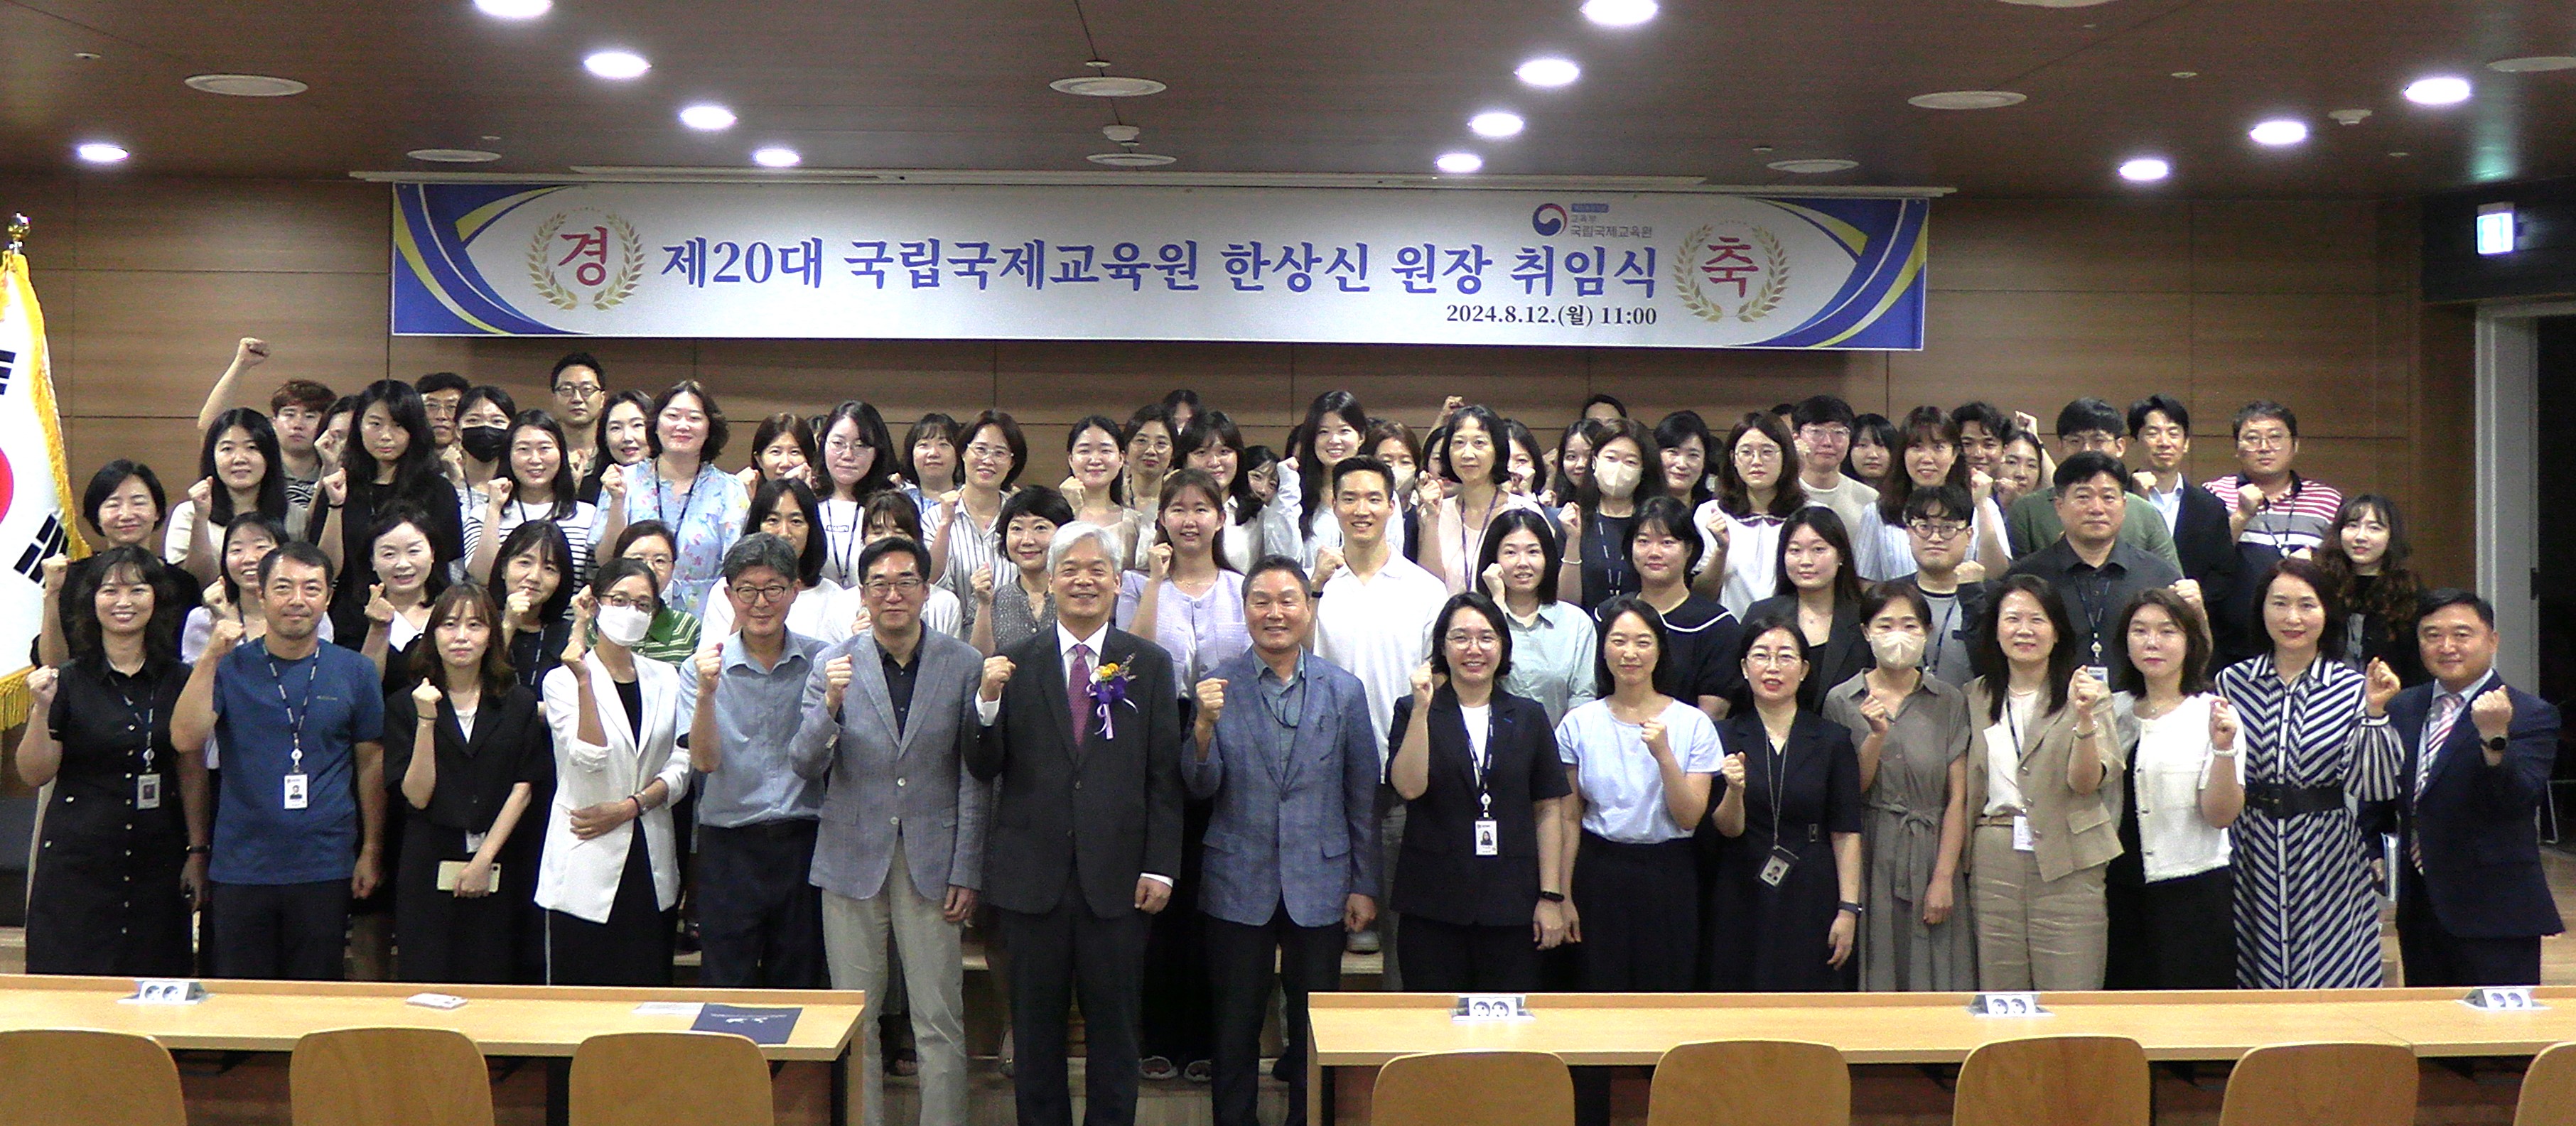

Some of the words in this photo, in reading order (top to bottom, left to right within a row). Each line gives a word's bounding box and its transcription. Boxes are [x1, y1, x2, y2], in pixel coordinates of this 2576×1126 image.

[559, 226, 609, 286] 경
[1570, 225, 1652, 238] 국립국제교육원
[662, 237, 823, 288] 제20대
[844, 238, 1200, 291] 국립국제교육원
[1221, 241, 1370, 293] 한상신
[1391, 243, 1492, 295] 원장
[1511, 245, 1656, 298] 취임식
[1699, 236, 1759, 298] 축
[1447, 304, 1593, 327] 2024.8.12.(월)
[1602, 307, 1657, 325] 11:00
